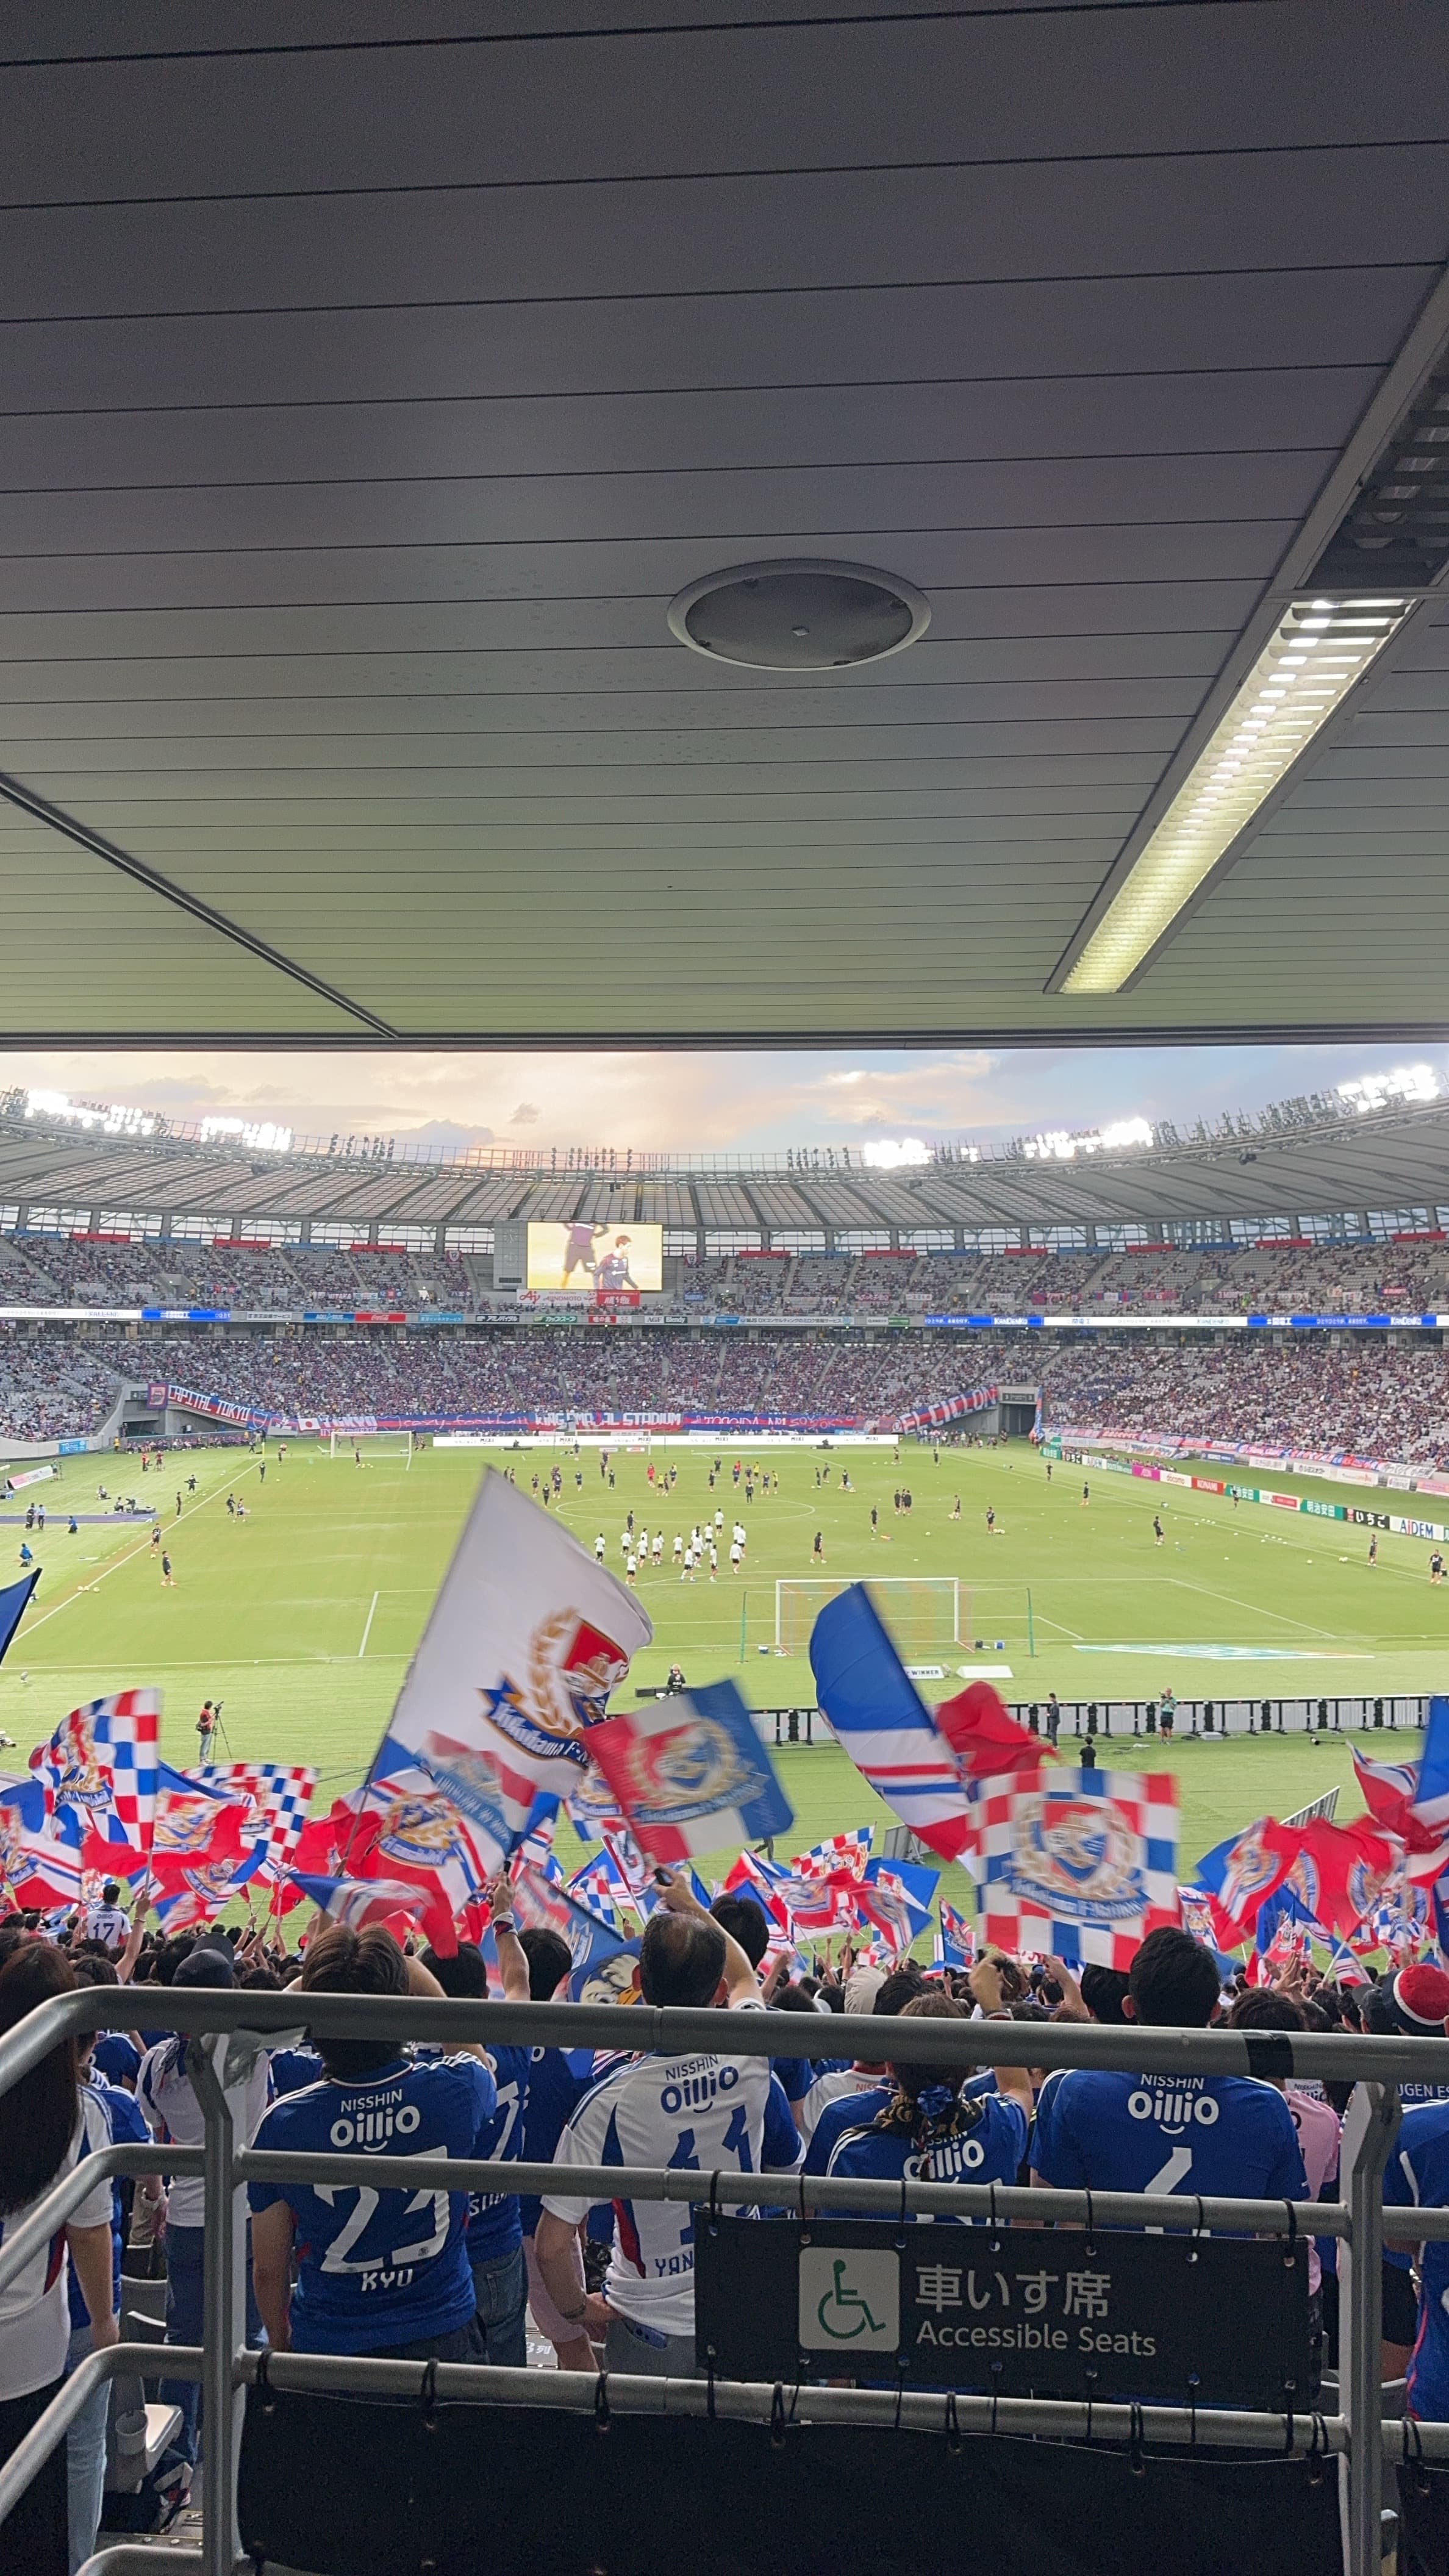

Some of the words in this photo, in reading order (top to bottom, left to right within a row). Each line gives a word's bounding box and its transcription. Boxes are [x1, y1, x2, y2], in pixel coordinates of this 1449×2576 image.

[168, 1384, 212, 1412] CAPITAL
[216, 1400, 251, 1421] TOKYO
[623, 1412, 681, 1426] STADIUM
[1307, 1500, 1336, 1517] 明治安田
[1356, 1511, 1386, 1528] いちご
[93, 1922, 115, 1942] 17
[665, 2053, 719, 2081] NISSHIN
[1140, 2073, 1205, 2091] NISSHIN
[340, 2088, 402, 2113] NISSHIN
[915, 2264, 1111, 2319] 車いす席
[916, 2320, 1068, 2350] Accessible
[1078, 2326, 1156, 2357] Seats
